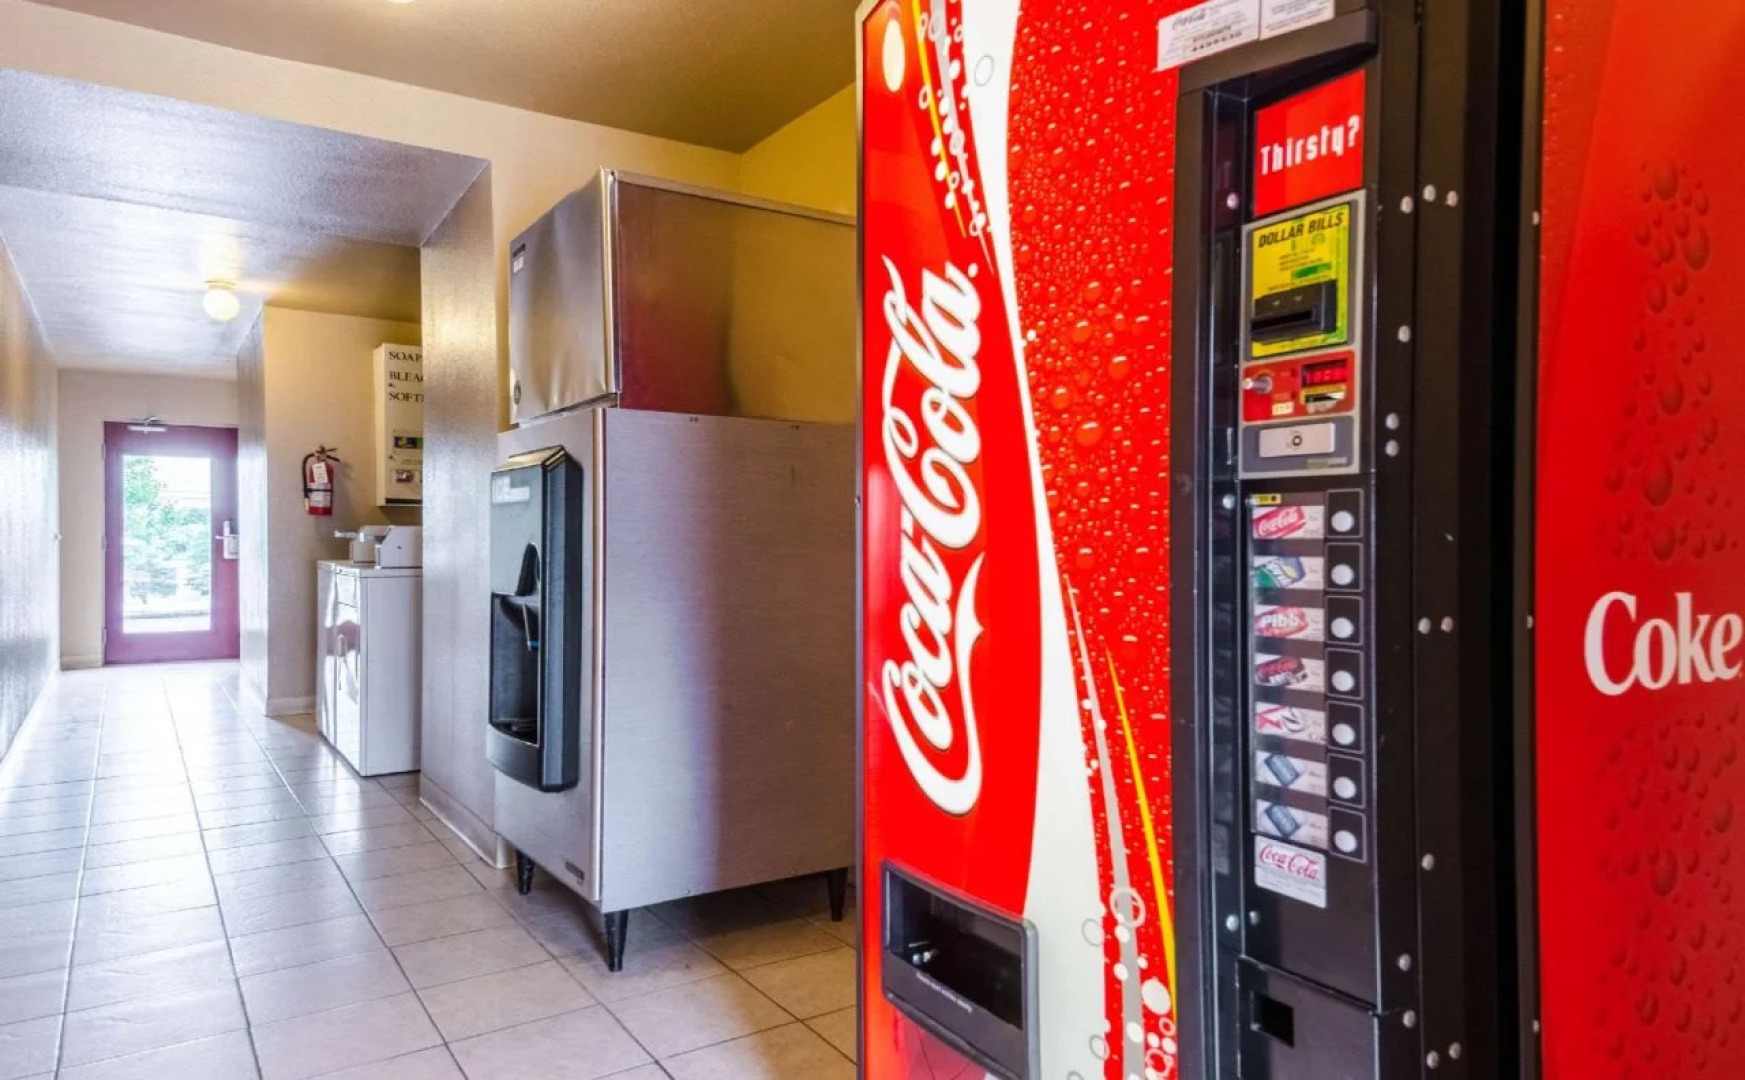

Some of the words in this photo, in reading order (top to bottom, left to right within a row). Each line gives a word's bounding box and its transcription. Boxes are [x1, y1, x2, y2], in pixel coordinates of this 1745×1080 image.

[1260, 115, 1360, 176] Thirsty?
[1258, 223, 1304, 248] DOLLAR
[1308, 212, 1344, 233] BILLS
[881, 255, 984, 817] Coca-Cola
[1584, 591, 1743, 696] Coke
